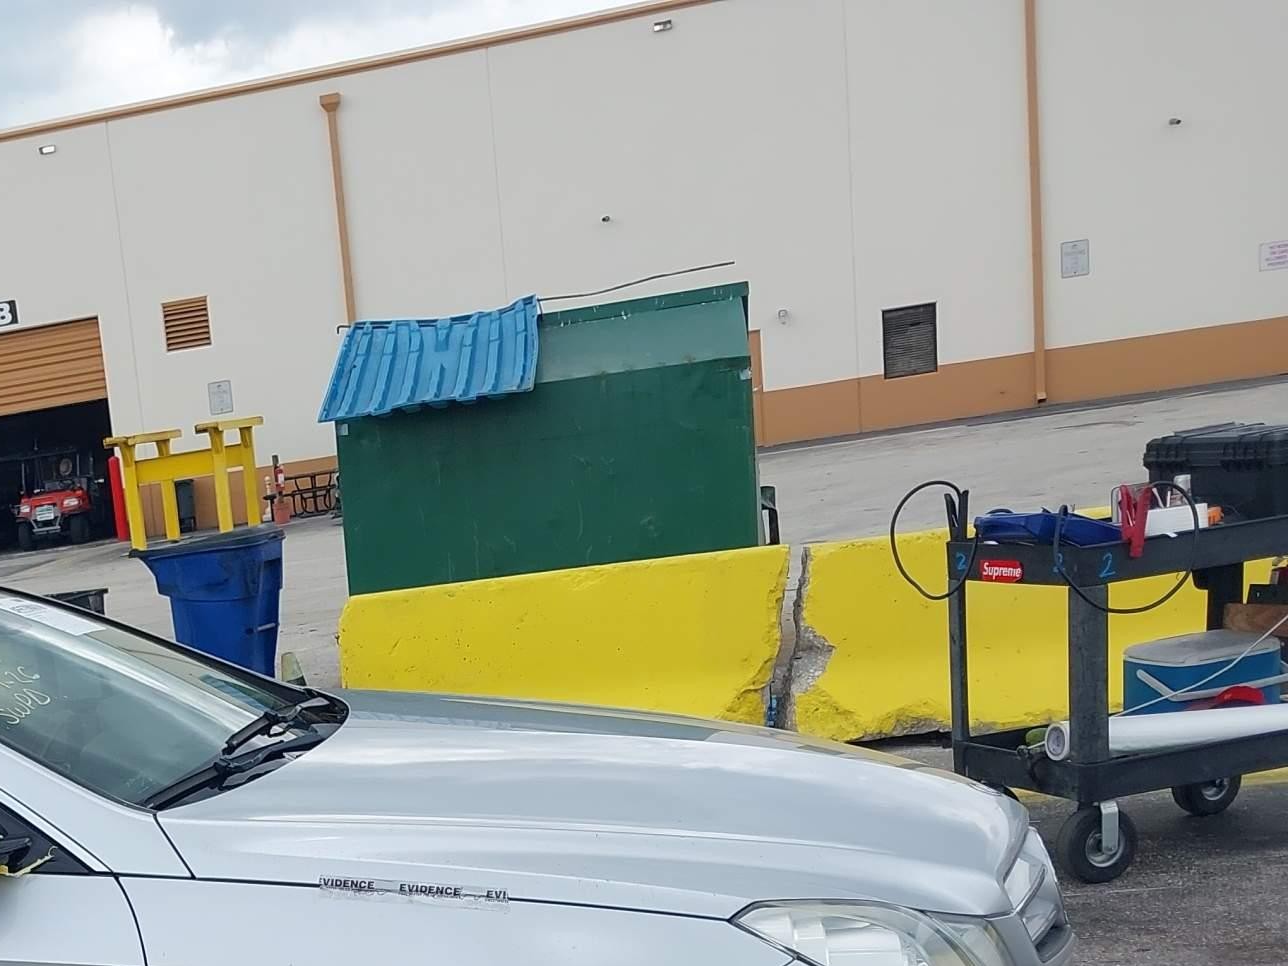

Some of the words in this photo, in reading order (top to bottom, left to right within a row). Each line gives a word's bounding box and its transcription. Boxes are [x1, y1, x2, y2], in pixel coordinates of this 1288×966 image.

[982, 562, 1023, 580] Supreme
[1099, 553, 1116, 578] 2
[399, 883, 462, 897] EVIDENCE
